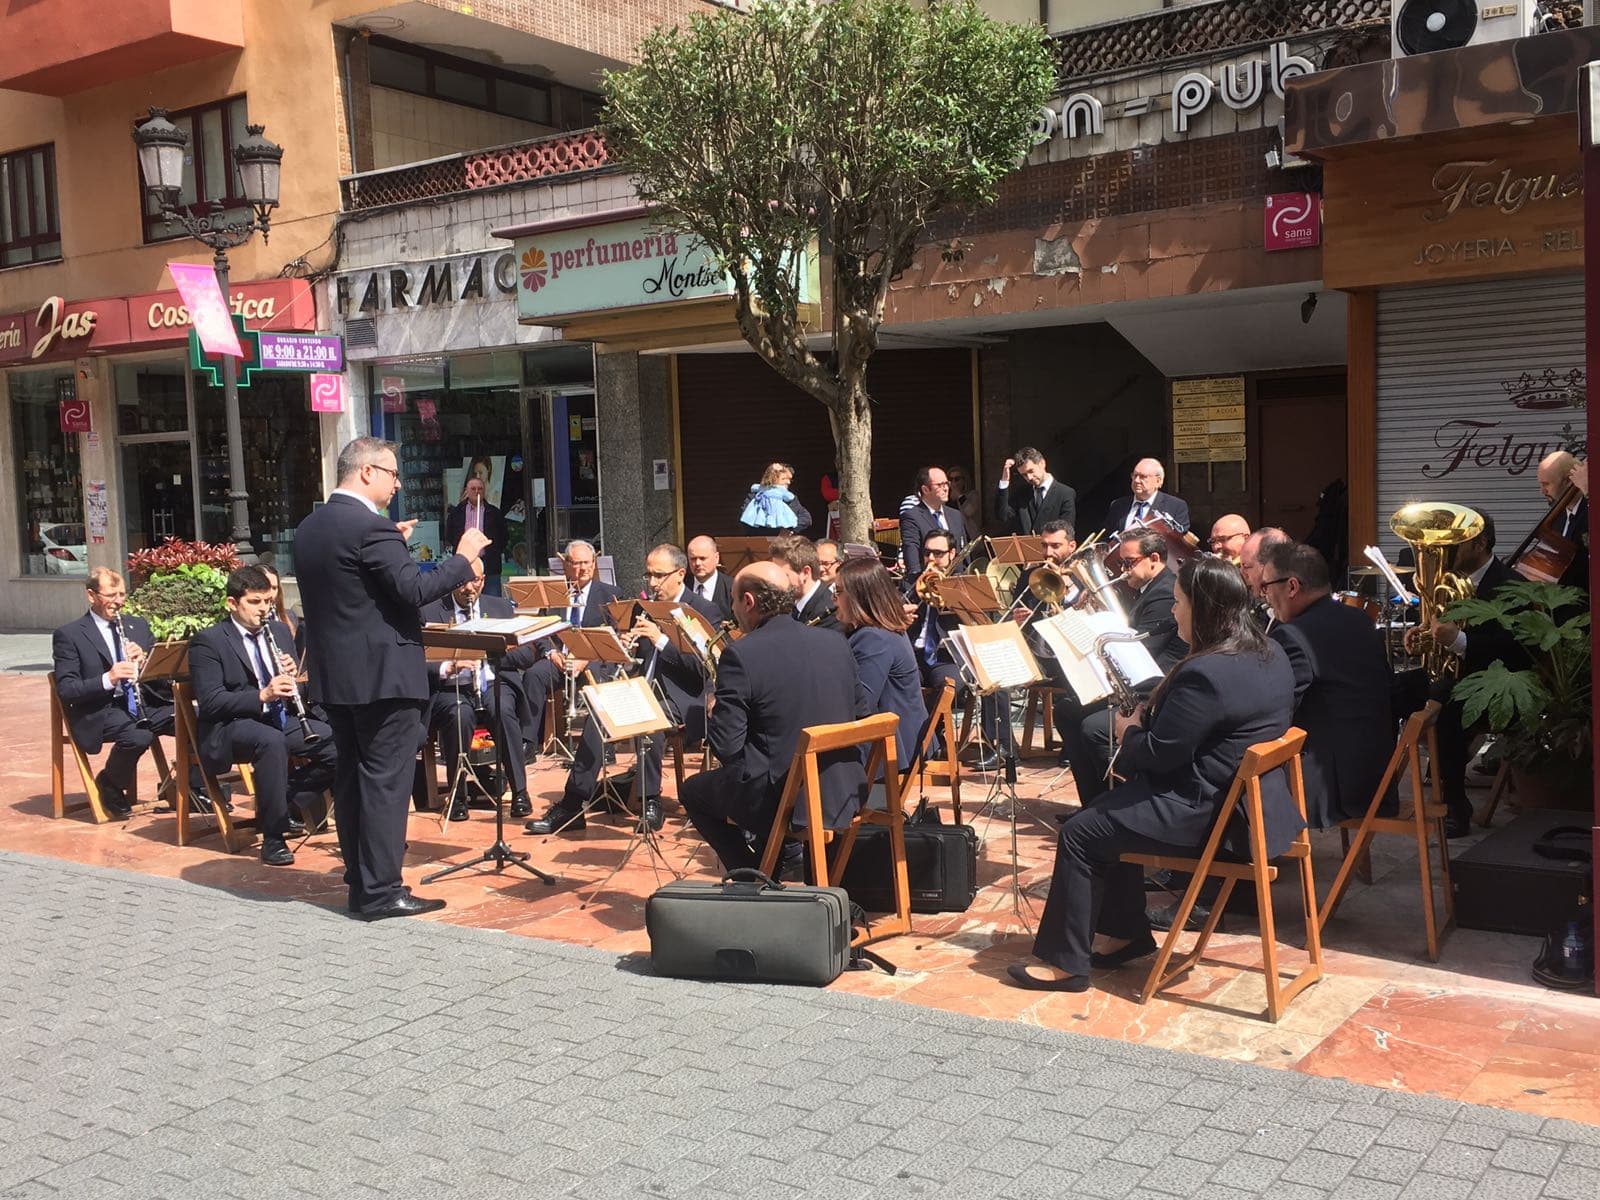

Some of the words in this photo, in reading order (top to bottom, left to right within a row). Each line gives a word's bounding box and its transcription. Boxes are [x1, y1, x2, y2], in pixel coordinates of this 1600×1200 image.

[1172, 41, 1315, 133] pub
[1423, 158, 1584, 224] Felgue
[1284, 228, 1312, 239] sama
[1413, 238, 1517, 266] JOYERIA
[337, 253, 517, 315] FARMAC
[31, 295, 97, 359] Jas
[148, 292, 275, 328] Cosica
[275, 344, 294, 359] 9:00
[303, 345, 327, 360] 21:00
